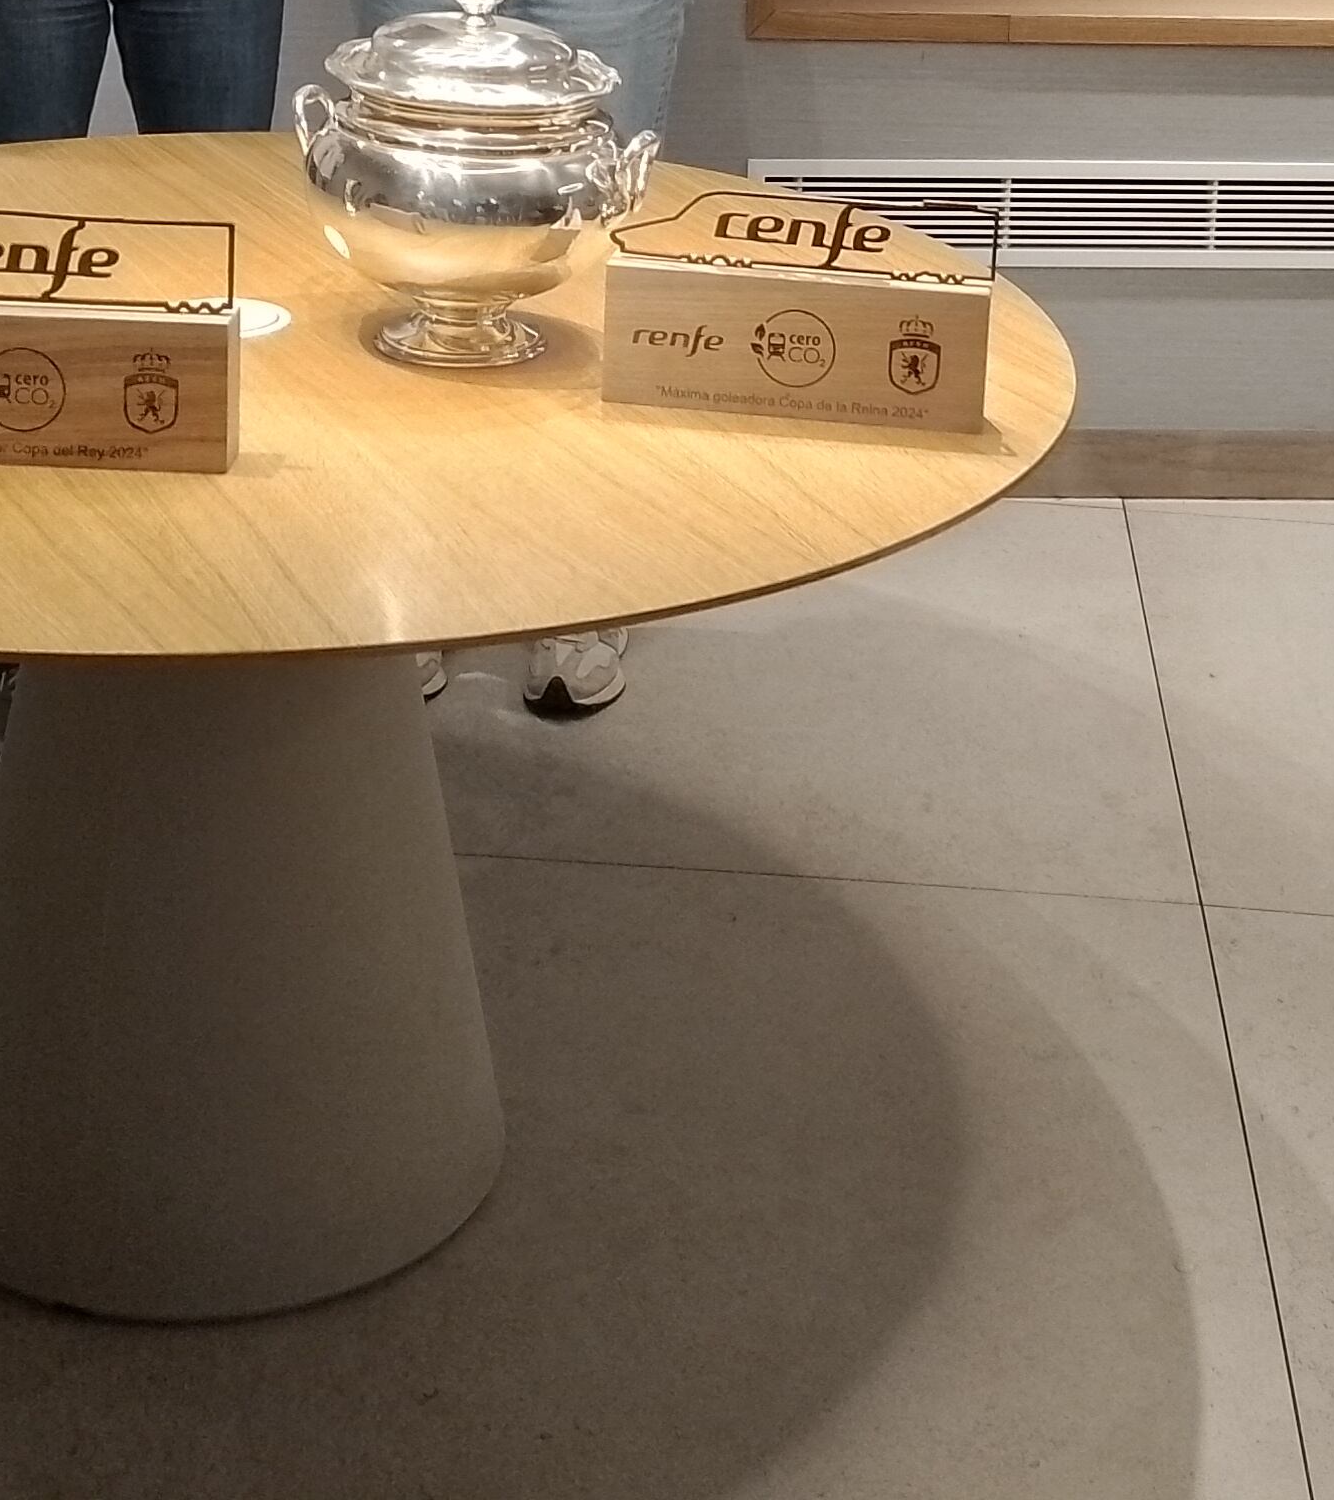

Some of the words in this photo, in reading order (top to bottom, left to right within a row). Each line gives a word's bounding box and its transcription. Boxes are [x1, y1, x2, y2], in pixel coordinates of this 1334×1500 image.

[714, 203, 891, 269] renfe
[632, 325, 724, 357] renfe
[789, 332, 821, 346] cero
[15, 372, 50, 387] cero
[712, 391, 776, 407] goleadora
[779, 396, 813, 411] Copa
[836, 401, 848, 413] la
[12, 443, 49, 458] Copa
[53, 445, 74, 457] del
[77, 445, 105, 461] Rey
